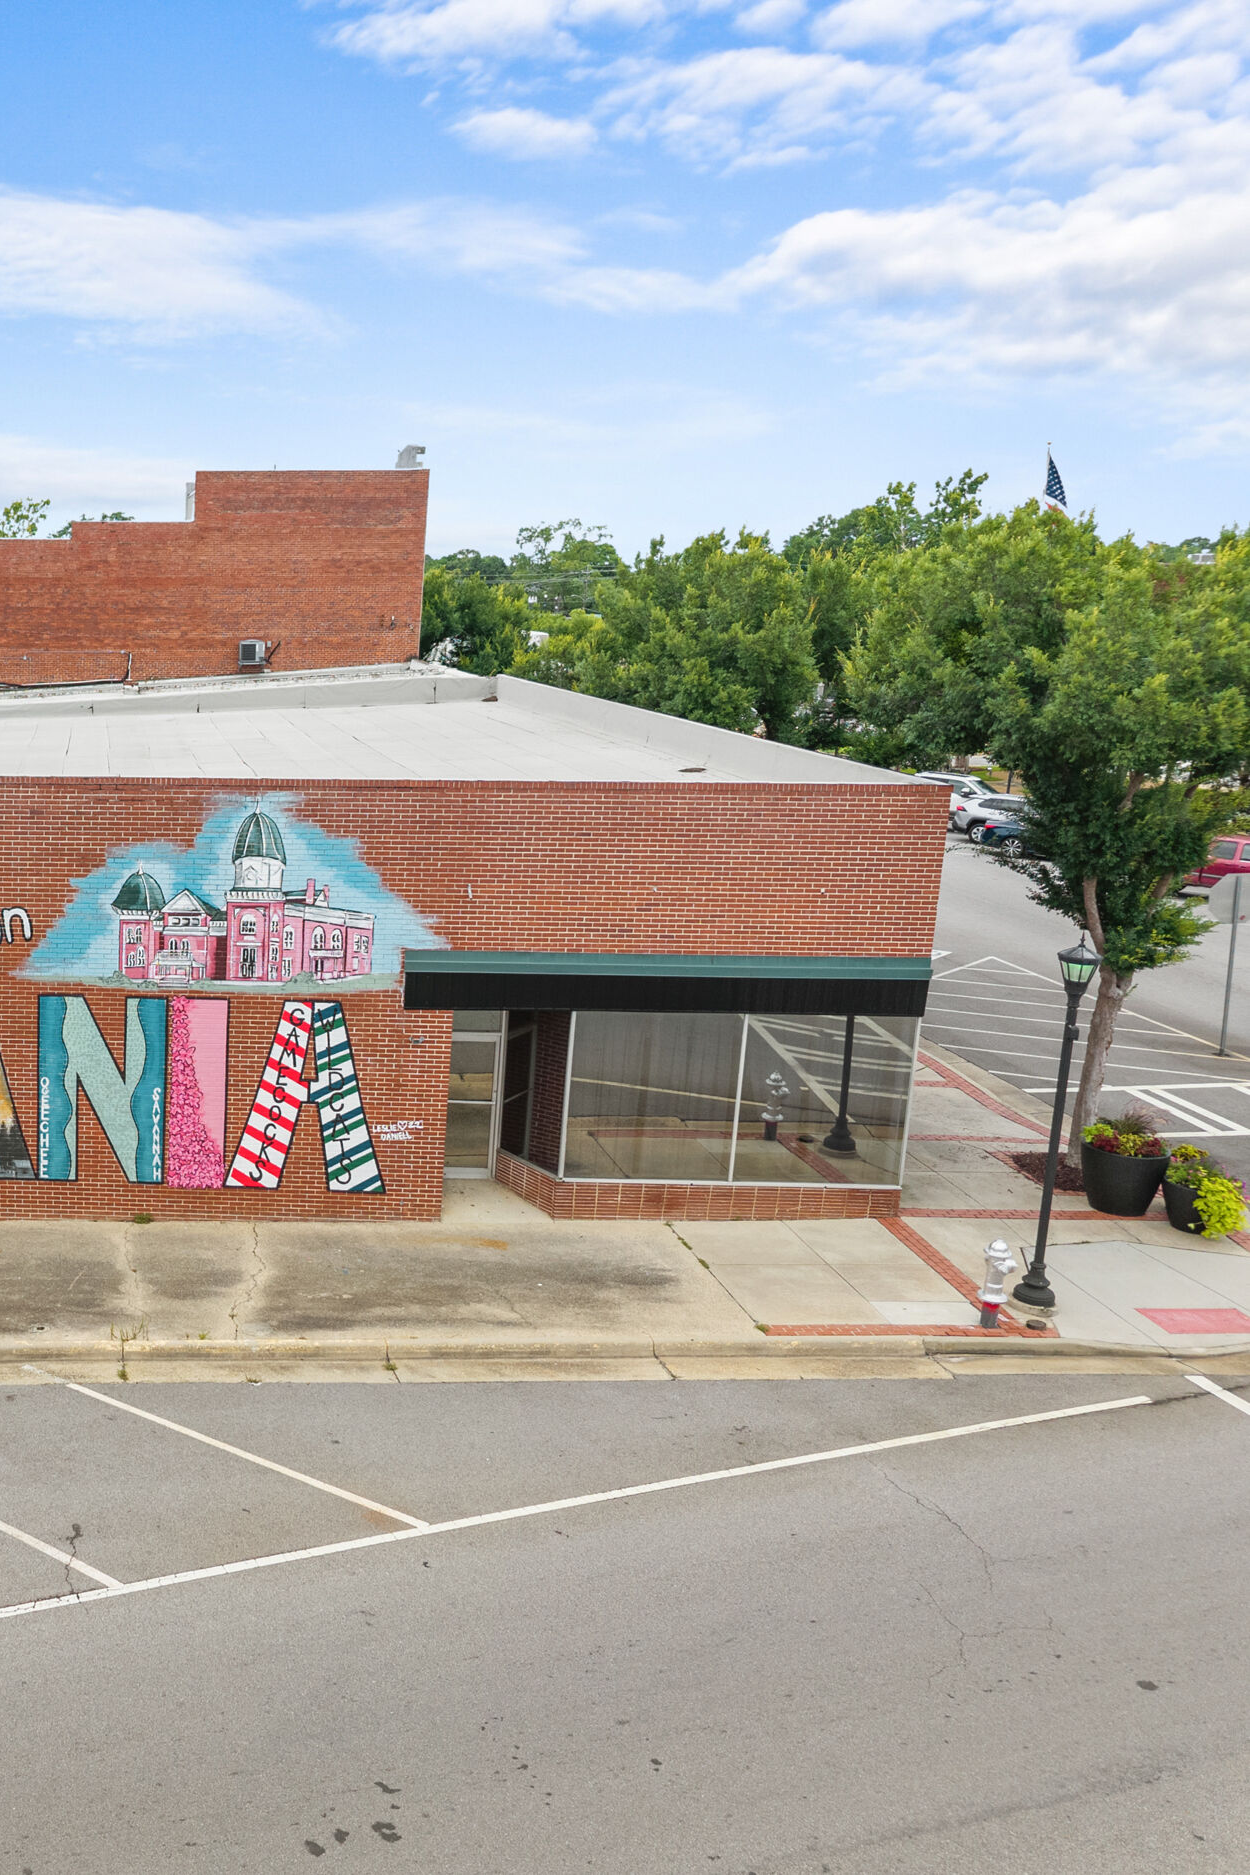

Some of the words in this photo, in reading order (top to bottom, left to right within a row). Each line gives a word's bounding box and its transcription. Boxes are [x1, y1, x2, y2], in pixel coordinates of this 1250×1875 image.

[39, 1076, 50, 1179] OGEECHEE
[151, 1087, 162, 1181] SAVANNAH
[249, 1008, 305, 1182] GAMECOCKS
[317, 1008, 352, 1184] WILDCATS
